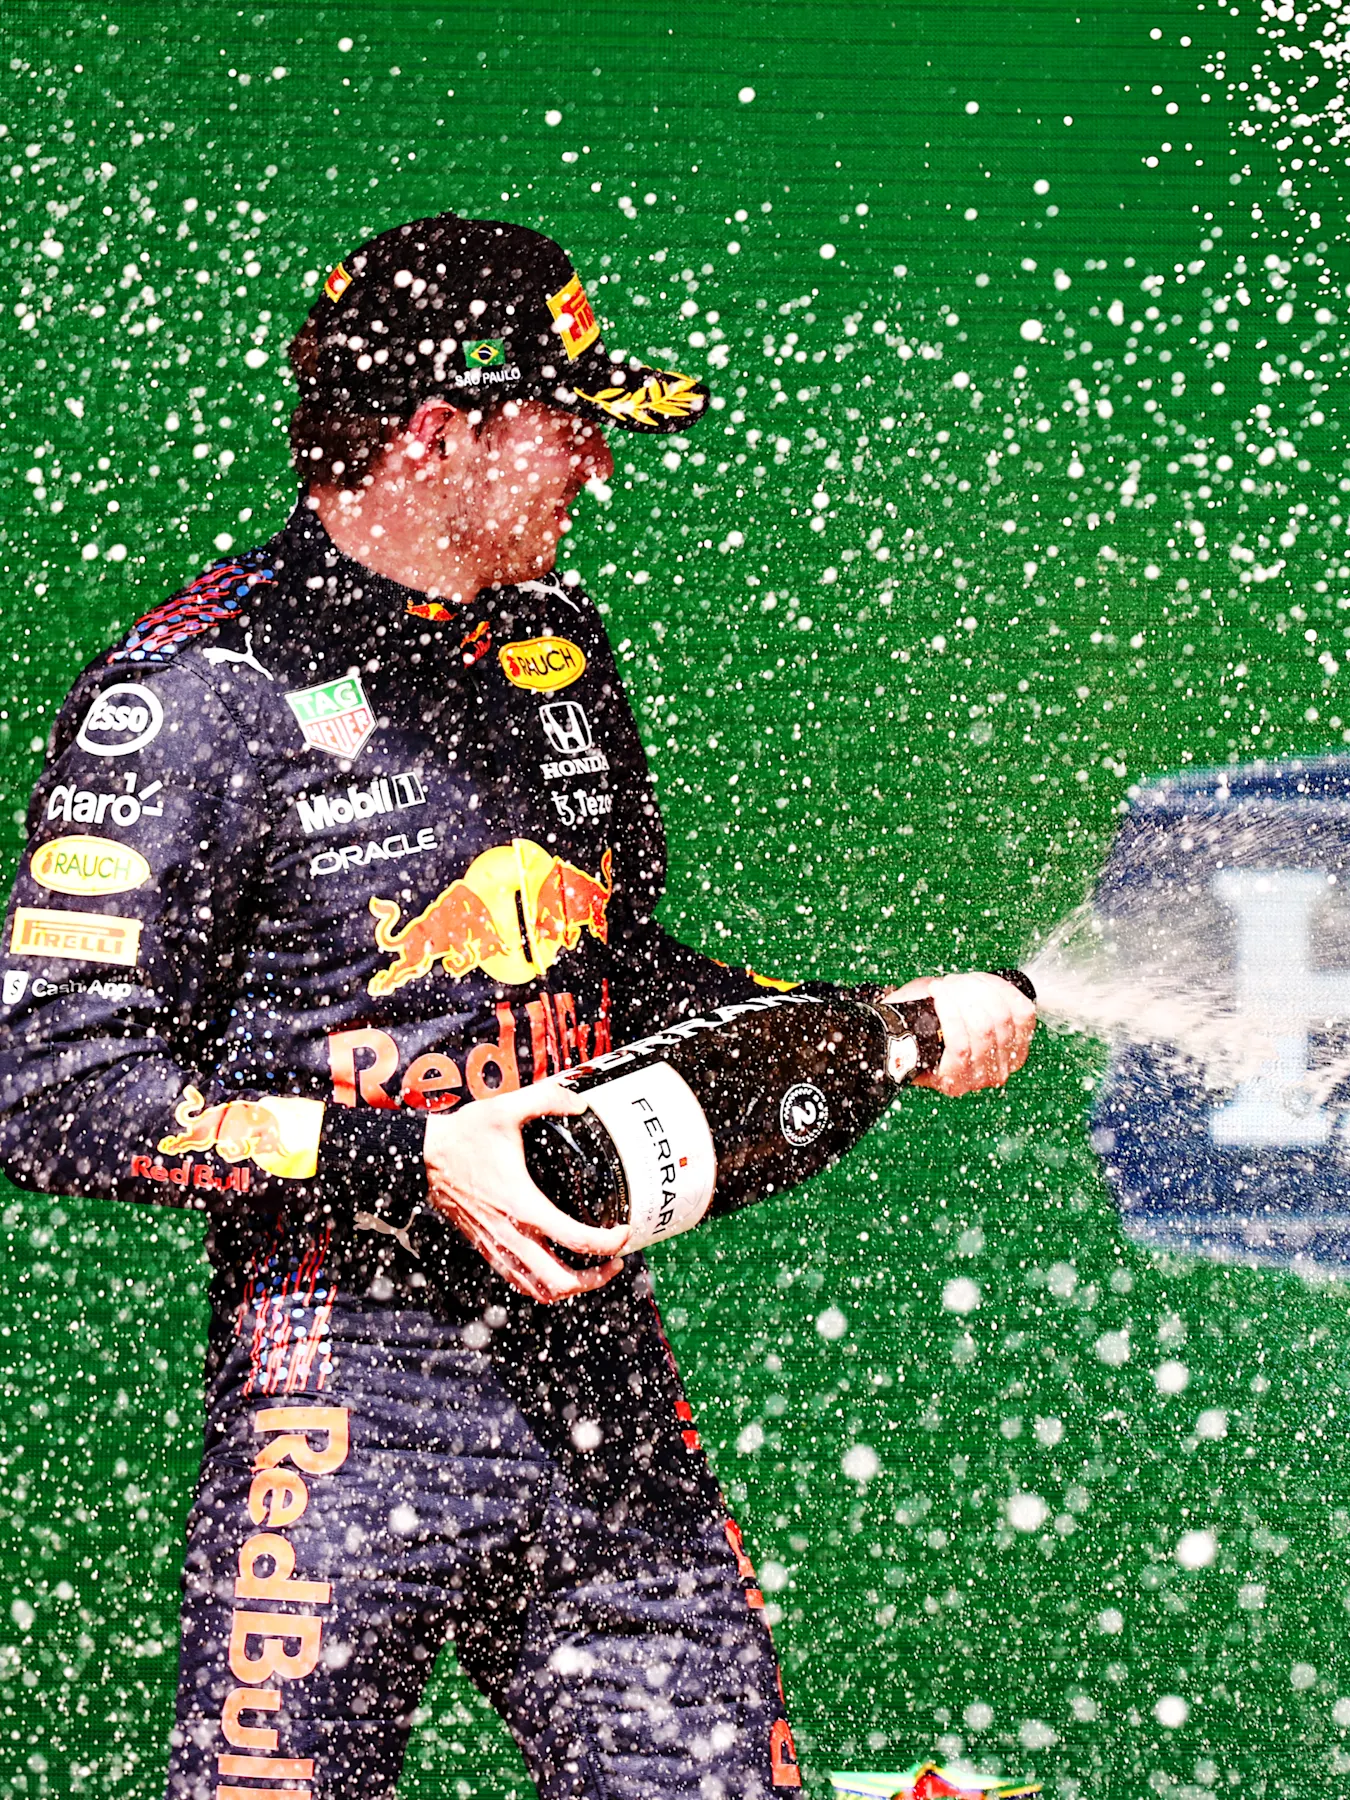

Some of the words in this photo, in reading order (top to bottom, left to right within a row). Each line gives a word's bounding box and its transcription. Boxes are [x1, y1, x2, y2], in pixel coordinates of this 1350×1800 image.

[483, 367, 521, 385] PAULO
[518, 648, 576, 677] RAUCH
[293, 682, 359, 718] TAG
[306, 708, 371, 755] HEUER
[540, 755, 610, 780] HONDA
[47, 784, 141, 827] Claro
[296, 777, 395, 834] Mobil
[54, 852, 132, 880] RAUCH
[309, 827, 438, 876] ORACLE
[21, 919, 127, 955] PIRELLI
[31, 978, 84, 998] Cash
[86, 979, 133, 1002] App
[328, 1001, 521, 1112] Red
[131, 1154, 193, 1186] Red
[631, 1097, 677, 1235] FERRARI
